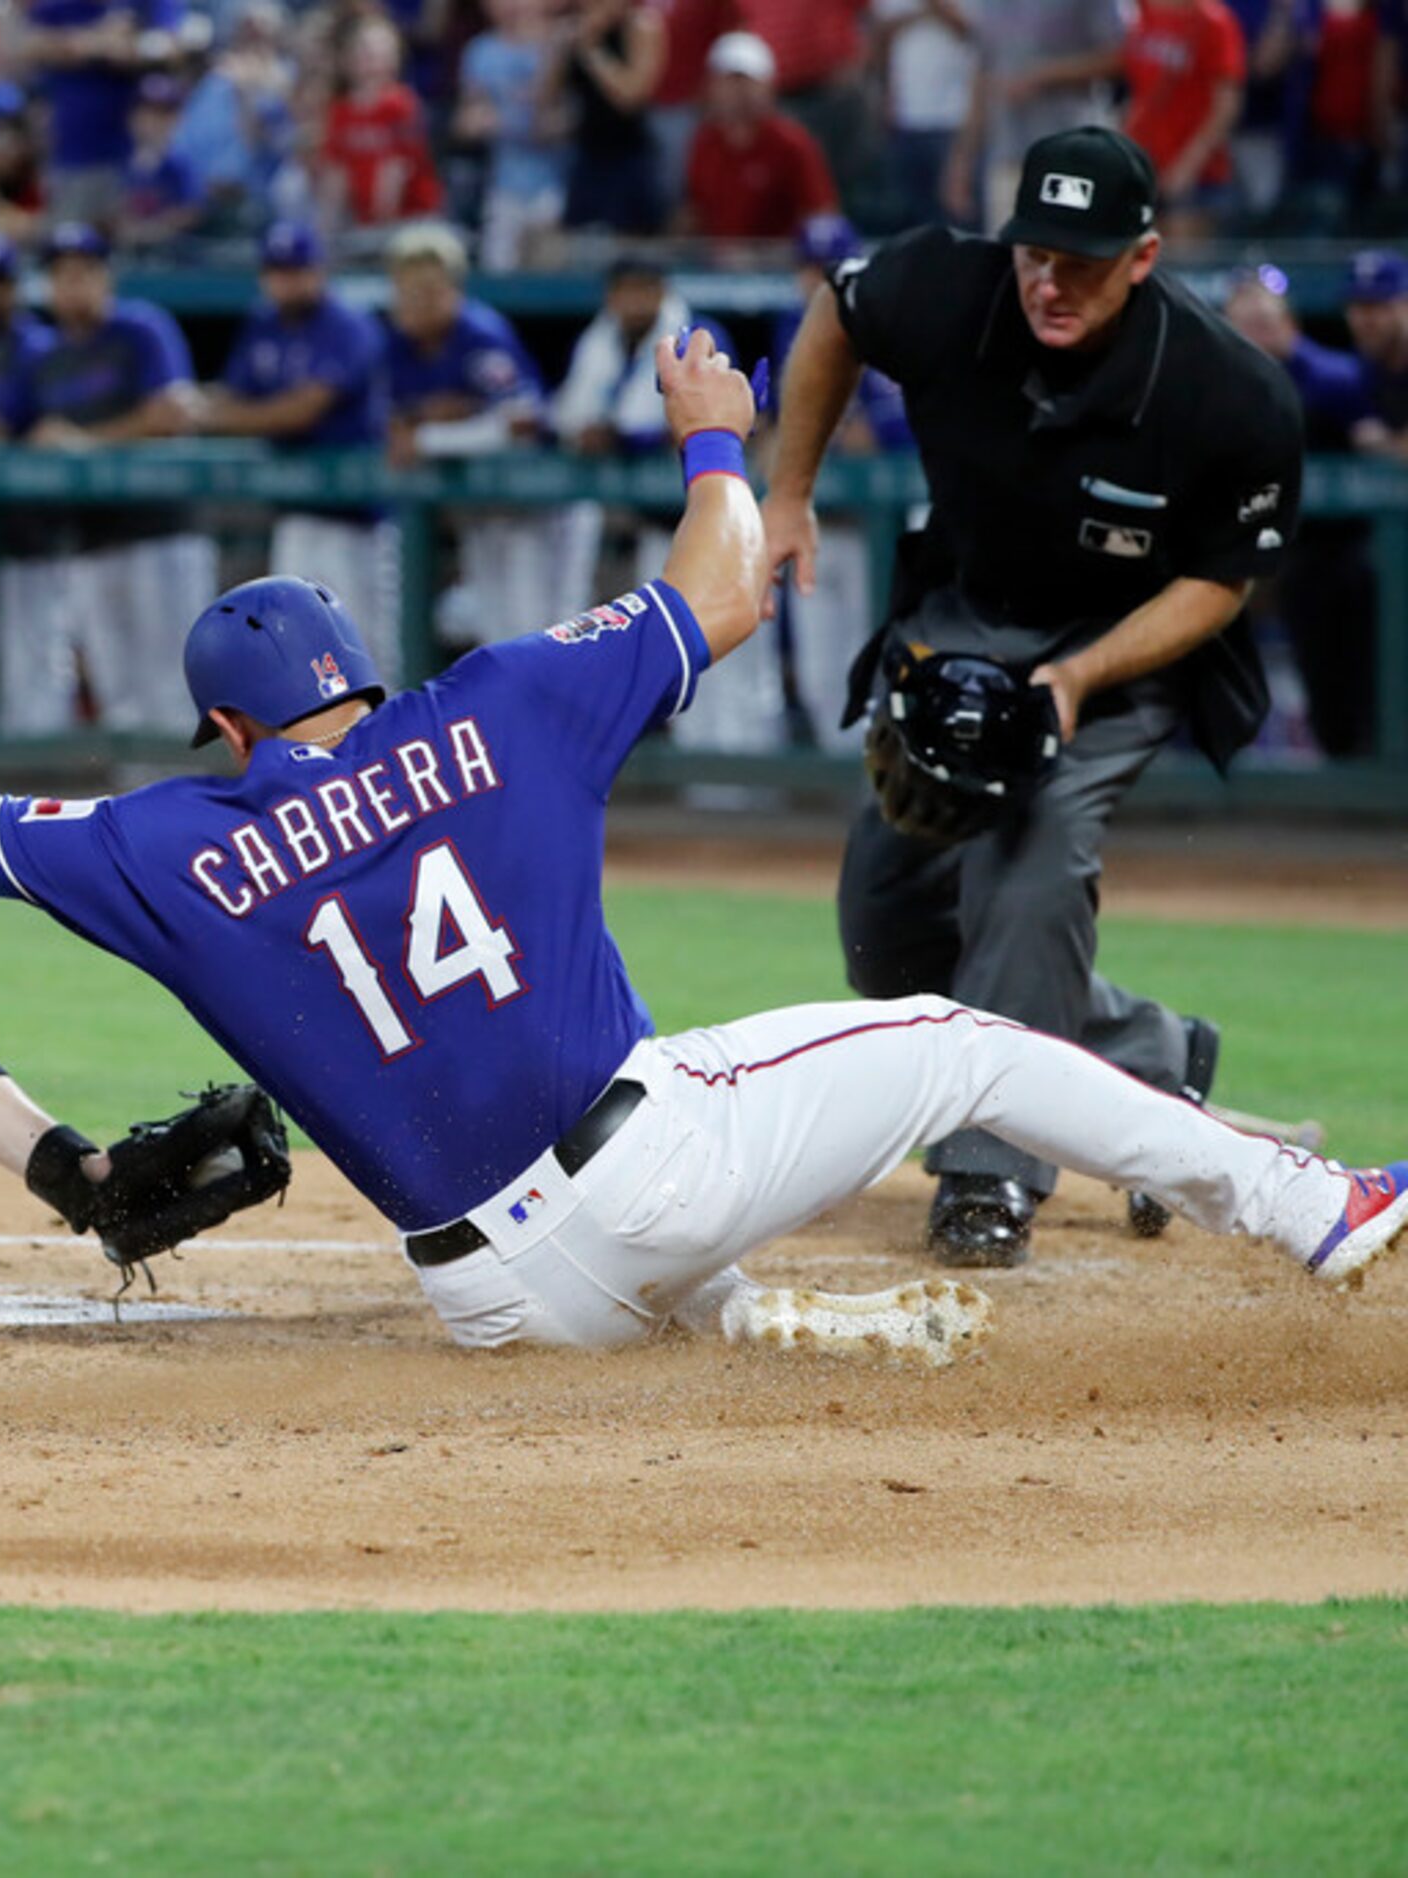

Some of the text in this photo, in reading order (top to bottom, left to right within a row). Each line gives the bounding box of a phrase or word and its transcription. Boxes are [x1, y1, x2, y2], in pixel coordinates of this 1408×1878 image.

[310, 652, 340, 681] 14
[190, 717, 504, 919] CABRERA
[303, 836, 531, 1065] 14
